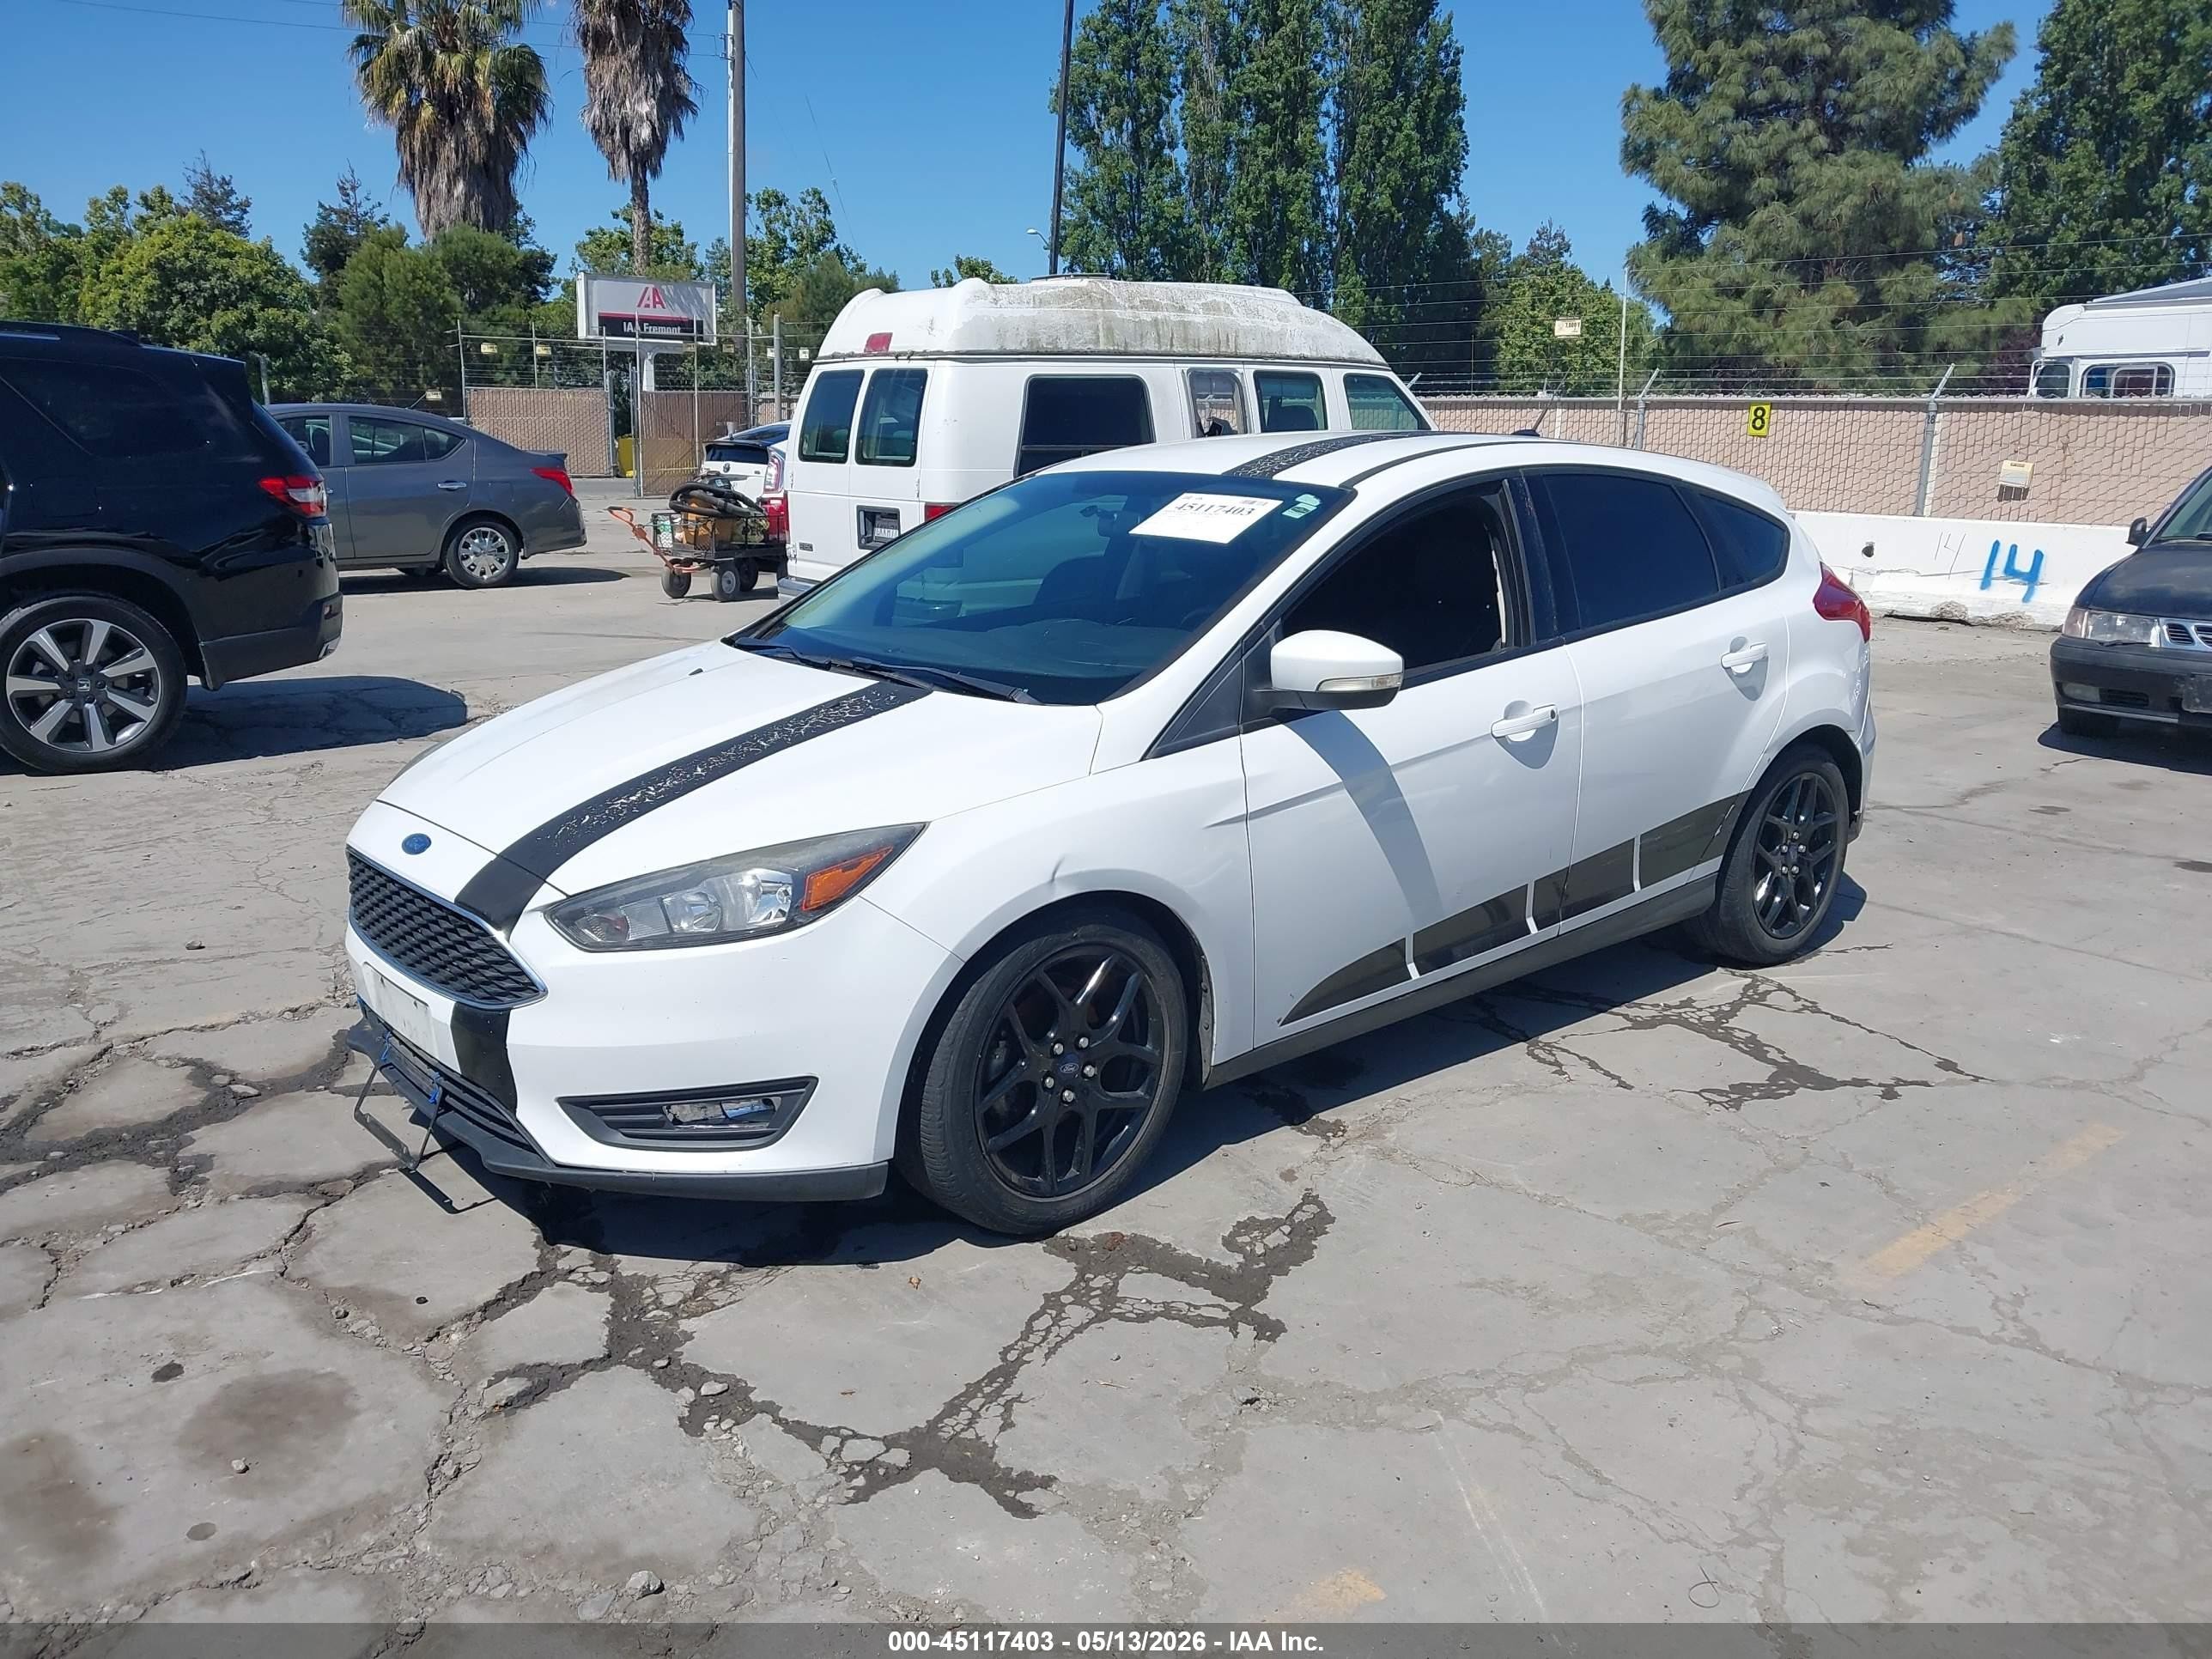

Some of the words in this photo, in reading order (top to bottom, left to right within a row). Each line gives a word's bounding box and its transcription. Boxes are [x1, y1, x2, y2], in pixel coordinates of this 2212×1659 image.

[644, 323, 681, 335] Fremont
[1752, 406, 1766, 431] 8
[1175, 502, 1255, 516] 45117403
[1935, 532, 1966, 580] 14
[1980, 539, 2044, 603] 14
